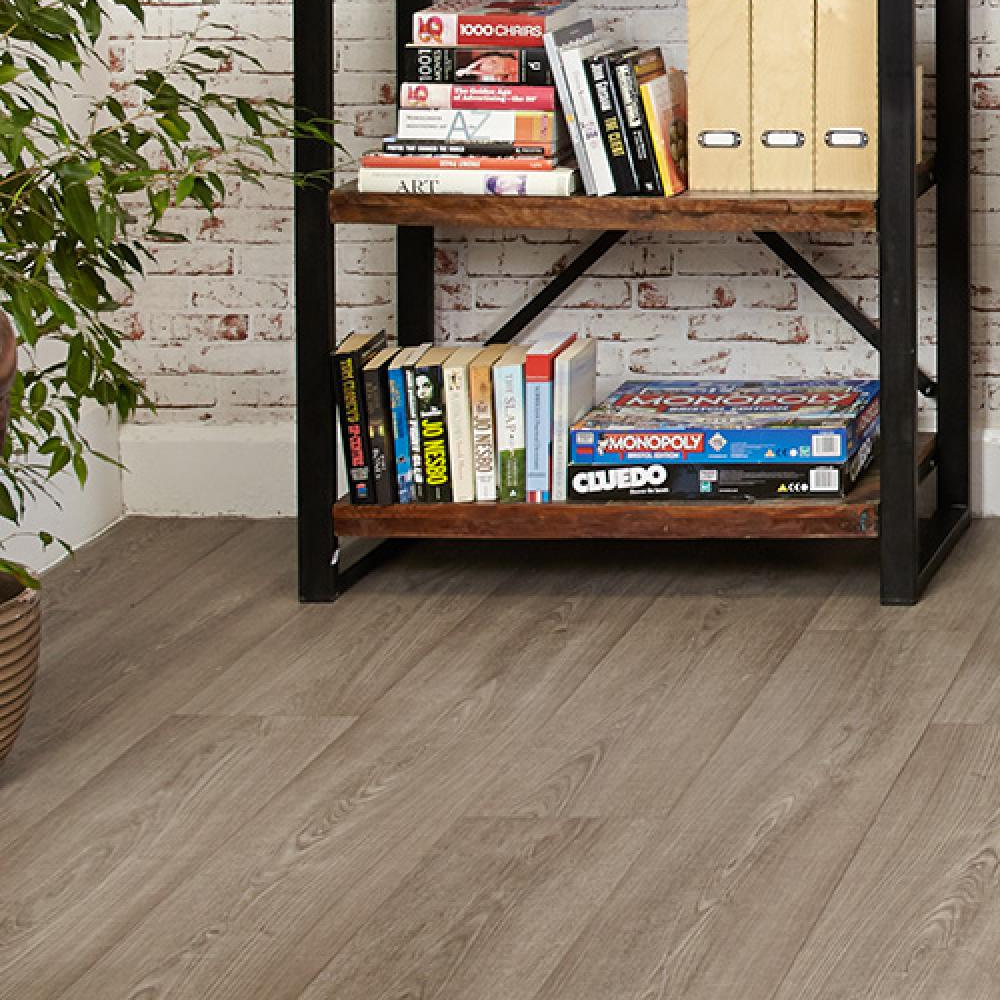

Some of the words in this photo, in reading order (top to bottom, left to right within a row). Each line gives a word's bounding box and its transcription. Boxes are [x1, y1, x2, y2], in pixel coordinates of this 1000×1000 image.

[459, 23, 494, 37] 1000
[495, 23, 543, 38] CHAIRS
[417, 48, 433, 81] 1001
[454, 87, 469, 95] The
[399, 179, 440, 193] ART
[623, 392, 857, 406] MONOPOLY
[505, 395, 518, 433] SLAP
[421, 419, 445, 437] JO
[473, 416, 492, 431] JO
[608, 434, 703, 452] MONOPOLY
[571, 464, 668, 493] CLUEDO
